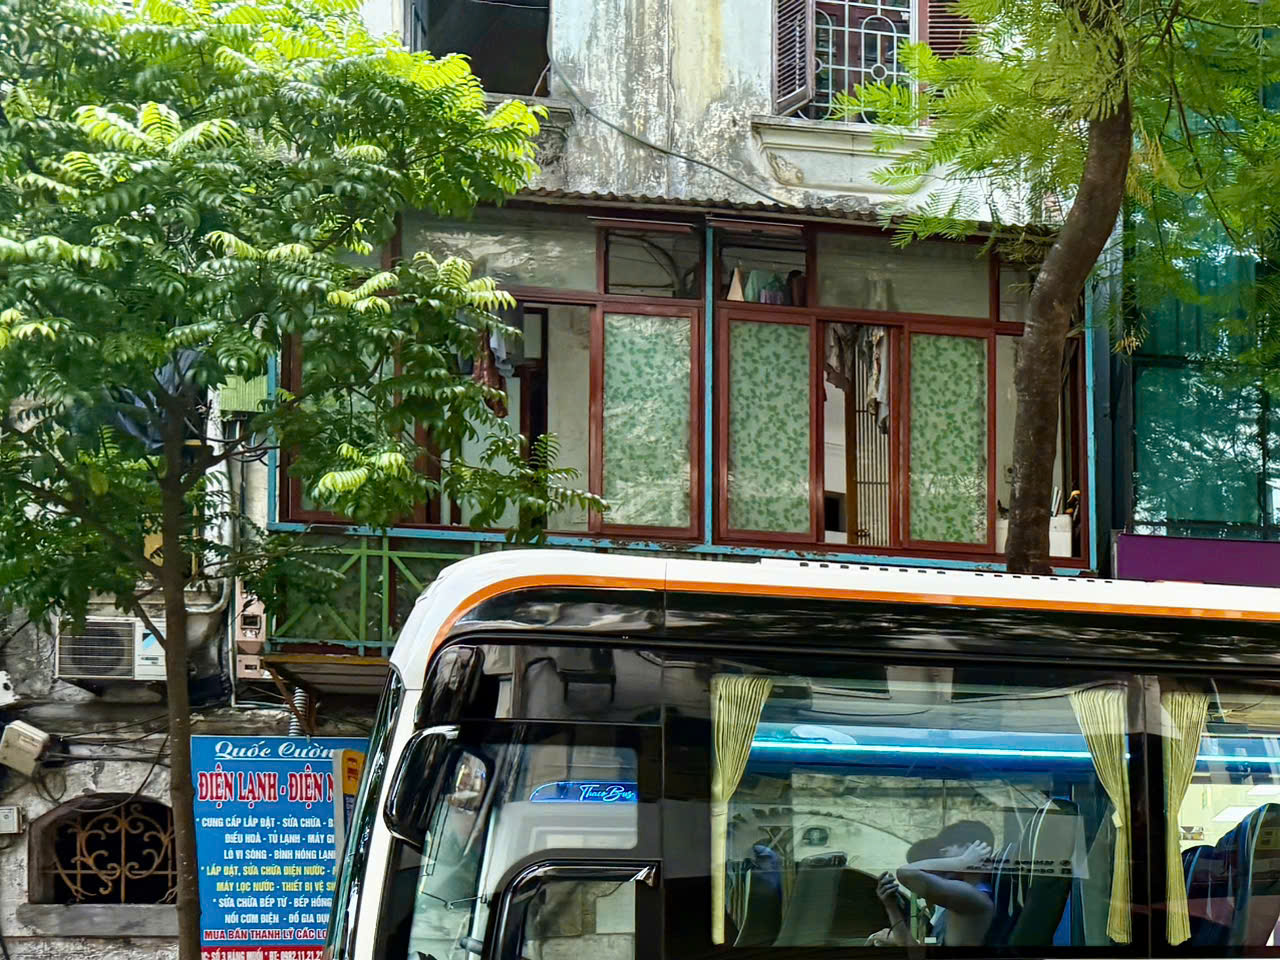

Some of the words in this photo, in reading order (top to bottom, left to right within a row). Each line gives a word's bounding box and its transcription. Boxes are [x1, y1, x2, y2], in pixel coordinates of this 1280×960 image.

[215, 740, 272, 760] Quốc
[278, 741, 334, 759] Cườn
[197, 762, 235, 809] ĐIỆN
[237, 770, 279, 810] LẠNH
[287, 763, 326, 810] ĐIỆN
[279, 833, 301, 846] LẠNH
[307, 831, 325, 844] MÁY
[203, 929, 226, 941] MUA
[249, 928, 281, 940] THANH
